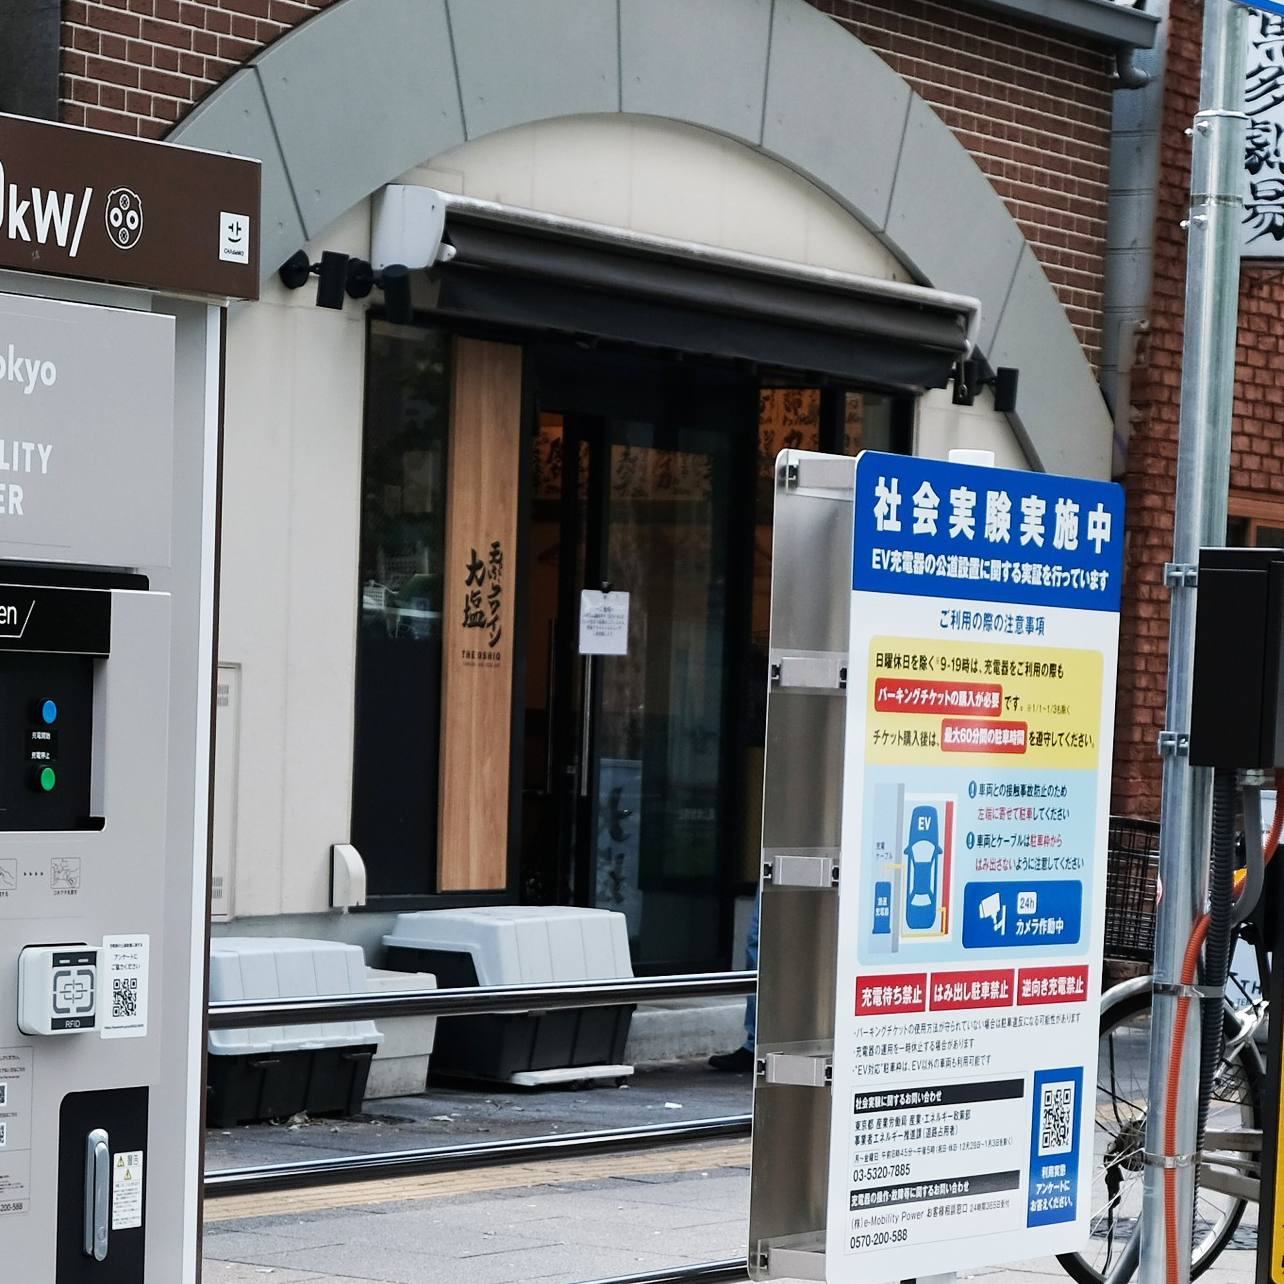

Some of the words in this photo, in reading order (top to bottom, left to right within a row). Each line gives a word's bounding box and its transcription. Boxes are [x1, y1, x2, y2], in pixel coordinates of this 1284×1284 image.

[874, 476, 1112, 554] 社会実験実施中
[872, 549, 1110, 591] EV充電器の公道設置に関する実証を行っています
[462, 548, 487, 628] 大塩
[939, 610, 1045, 635] ご利用の際の注意事項
[462, 650, 476, 659] THE
[878, 687, 1000, 708] パーキングチケットの購入が必要
[944, 728, 1025, 746] 最大60分間の駐車時間
[978, 782, 1067, 798] 車両との接触事故防止のため
[978, 807, 1070, 821] 左端に寄せて駐車してください
[918, 817, 931, 831] EV
[976, 834, 1062, 848] 車両とケーブルは駐車枠から
[975, 856, 1084, 872] はみ出さないように注意してください
[1020, 897, 1034, 908] 24h
[1016, 917, 1064, 936] カメラ作動中
[861, 985, 923, 1007] 充電待ち禁止
[934, 980, 1008, 1003] はみ出し駐車禁止
[1022, 976, 1084, 997] 逆向き充電禁止
[65, 1020, 81, 1028] RFID
[855, 1091, 942, 1111] 社会実験に関するお問い合わせ
[855, 1118, 874, 1131] 東京都
[853, 1163, 911, 1182] 03-5320-7885
[1036, 1180, 1070, 1195] アンケートに
[901, 1210, 924, 1221] Power
[850, 1229, 908, 1249] 0570-200-588
